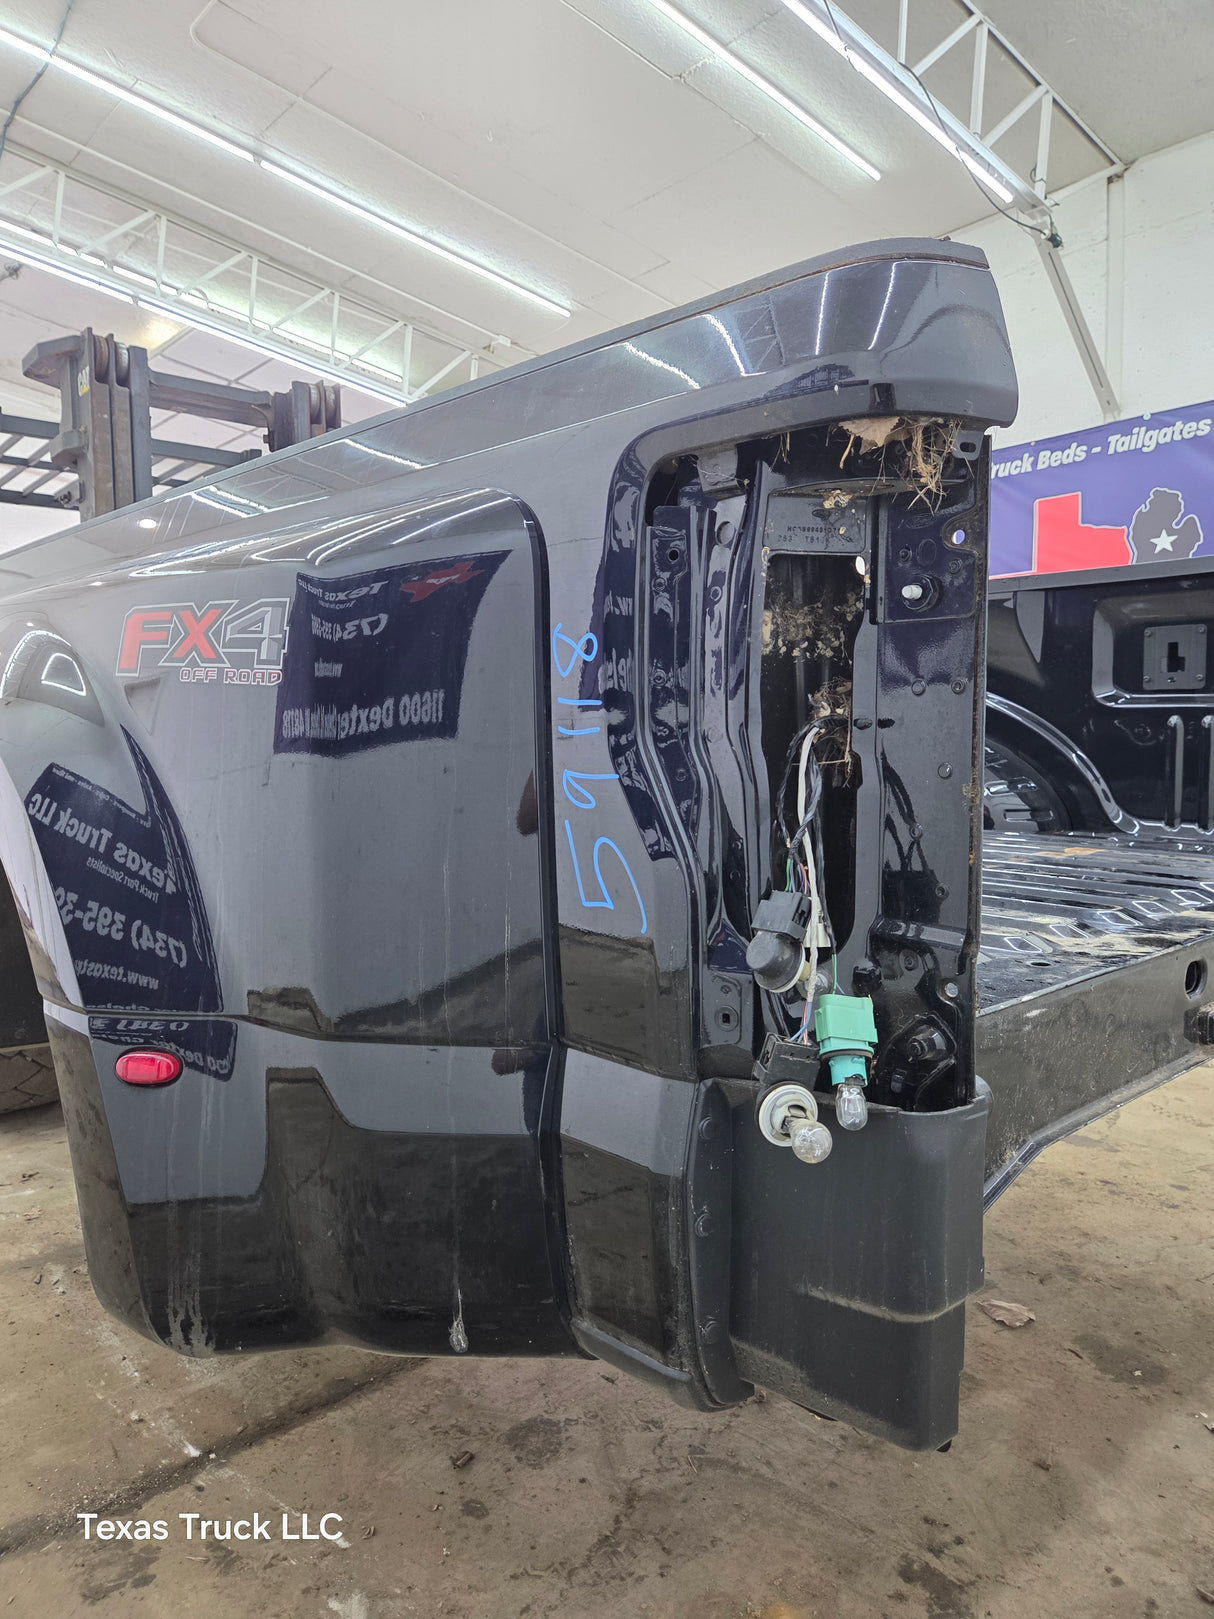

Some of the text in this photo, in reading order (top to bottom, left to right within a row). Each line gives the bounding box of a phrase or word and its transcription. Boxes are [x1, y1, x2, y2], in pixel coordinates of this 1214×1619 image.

[1036, 442, 1088, 471] Beds
[1107, 418, 1212, 455] Tailgates
[115, 598, 290, 677] FX4
[179, 667, 283, 686] OFF ROAD
